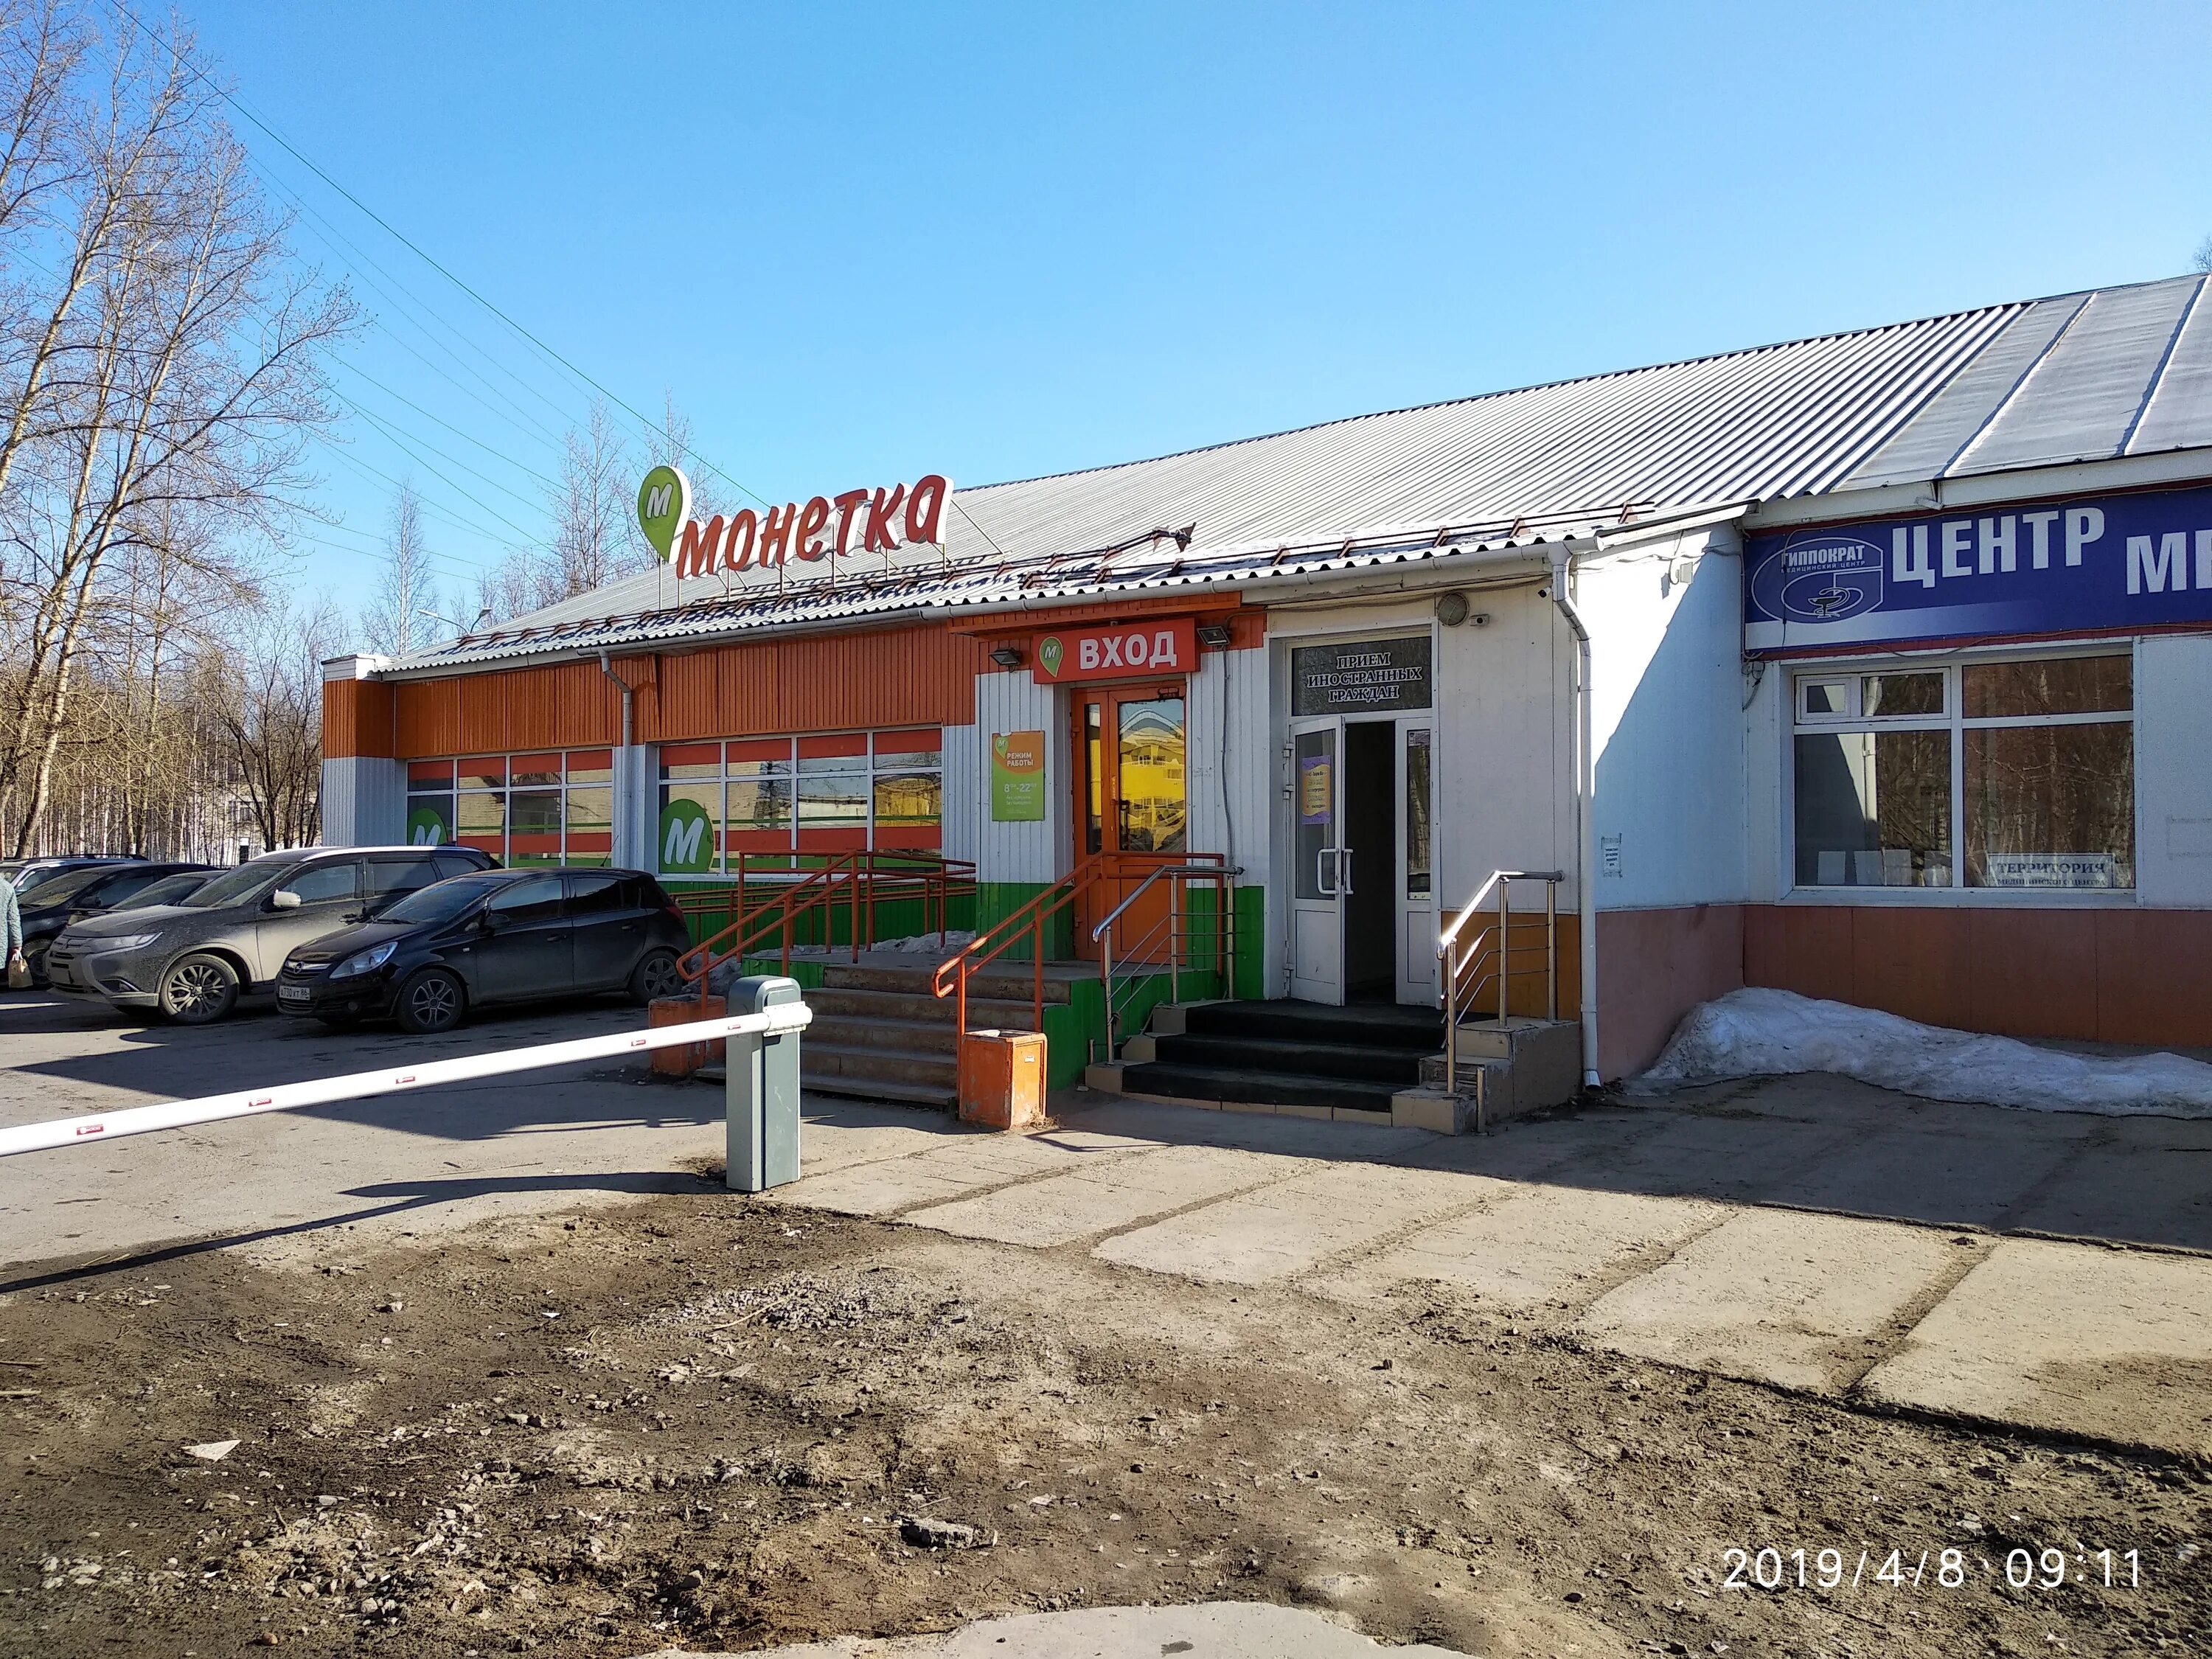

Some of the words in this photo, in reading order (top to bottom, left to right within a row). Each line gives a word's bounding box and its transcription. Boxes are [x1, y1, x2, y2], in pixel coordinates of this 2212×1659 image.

[1781, 545, 1865, 568] ГИППОКРАТ
[1892, 507, 2105, 588] ЦЕНТР
[1840, 560, 1865, 568] ЦЕНТР
[1079, 630, 1178, 669] ВХОД
[1336, 652, 1391, 669] ПРИЕМ
[1307, 667, 1422, 687] ИНОСТРАННЫХ
[1328, 686, 1400, 703] ГРАЖДАН
[1006, 759, 1034, 767] РАБОТЫ
[664, 817, 705, 865] М
[1997, 863, 2106, 874] ТЕРРИТОРИЯ
